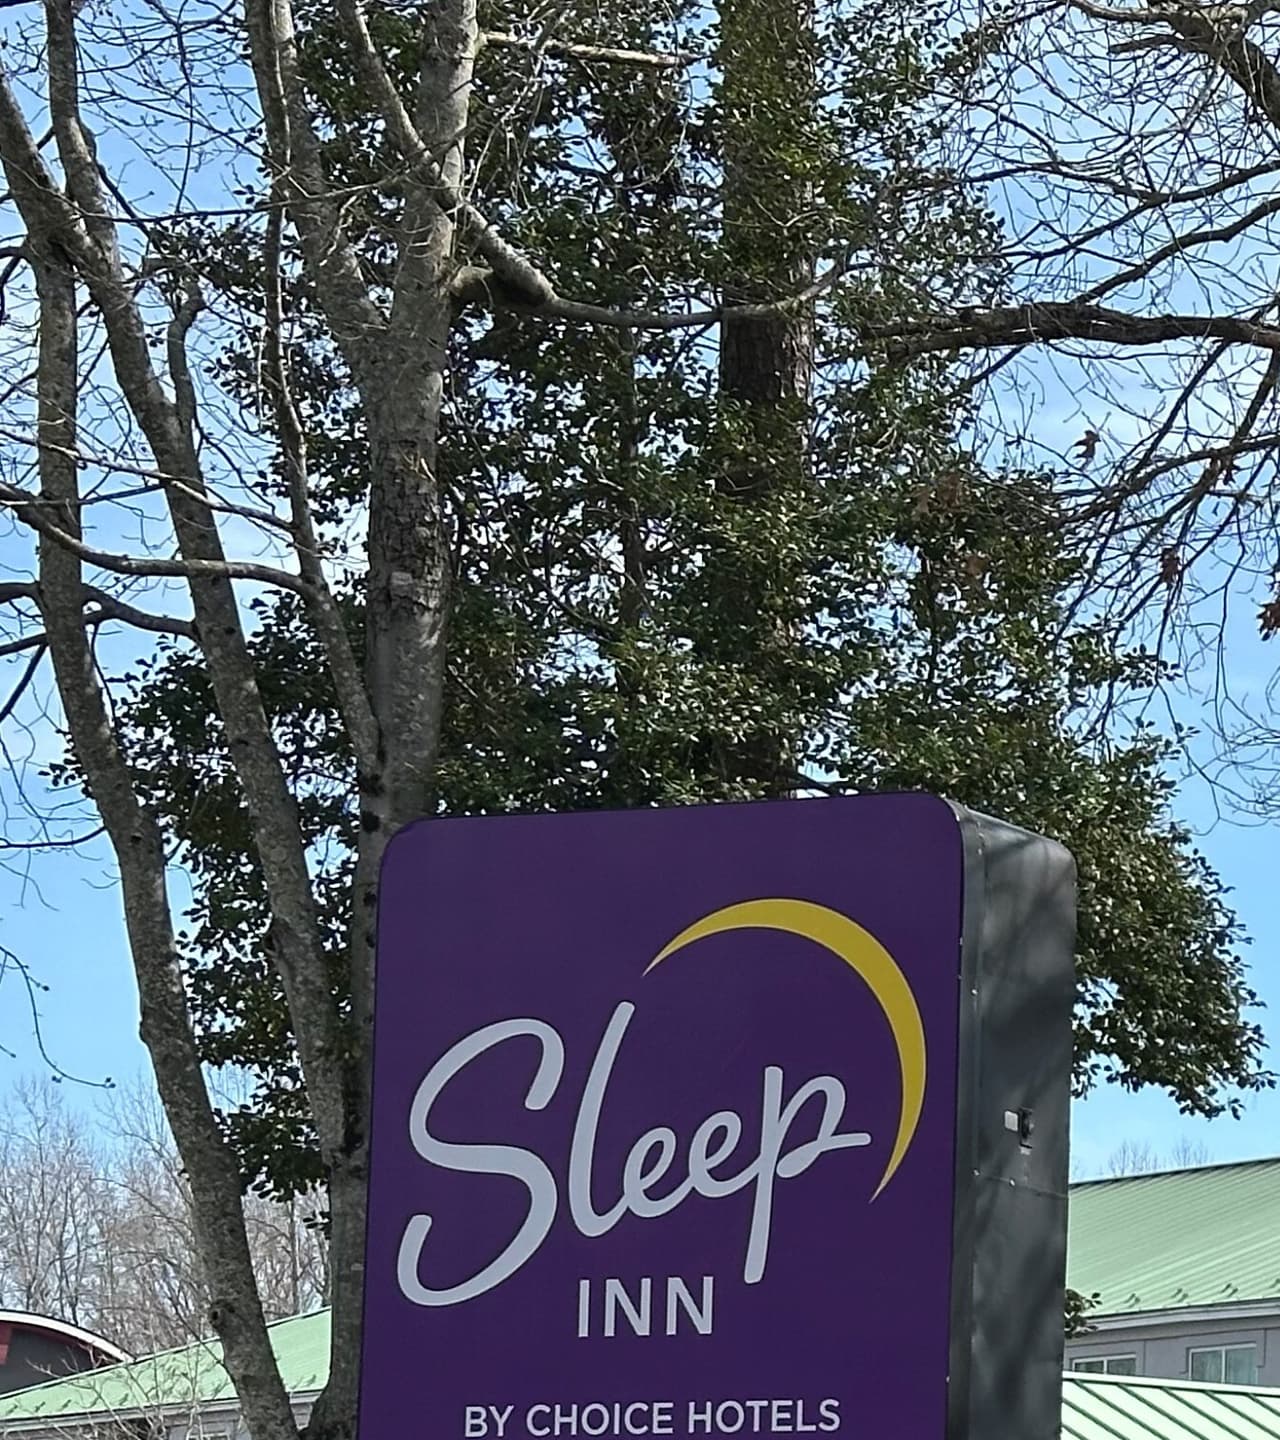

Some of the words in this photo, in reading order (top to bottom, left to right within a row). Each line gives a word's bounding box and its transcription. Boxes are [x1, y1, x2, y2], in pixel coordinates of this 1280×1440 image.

[397, 1000, 872, 1307] Sleep
[578, 1276, 714, 1338] INN
[465, 1405, 514, 1438] BY
[526, 1402, 674, 1437] CHOICE
[688, 1398, 841, 1434] HOTELS
